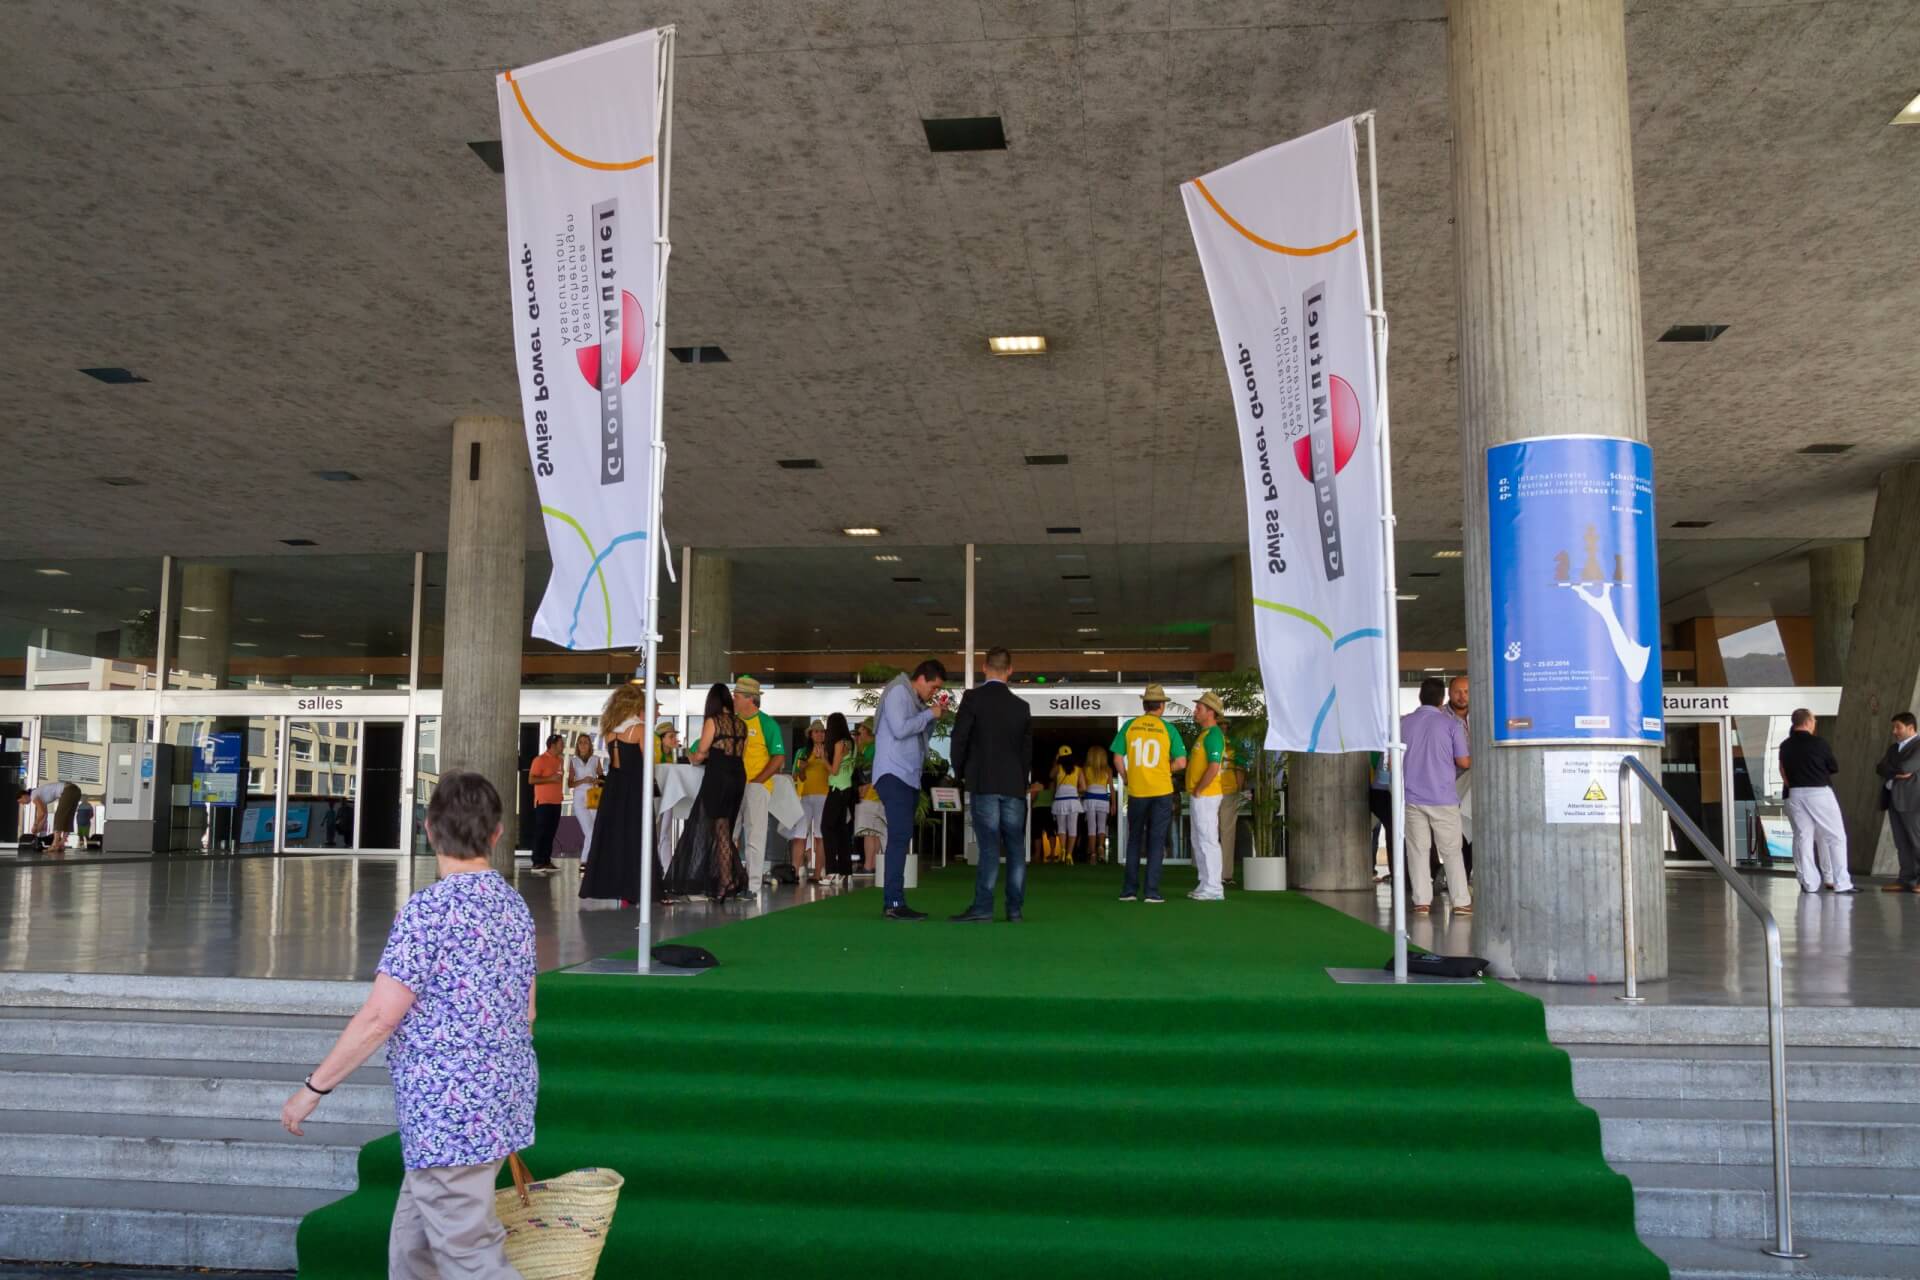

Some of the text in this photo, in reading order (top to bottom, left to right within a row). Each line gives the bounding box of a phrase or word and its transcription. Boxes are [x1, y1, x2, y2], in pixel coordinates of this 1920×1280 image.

[1582, 486, 1609, 495] Chess
[298, 695, 343, 710] salles
[1049, 695, 1101, 710] salles
[1662, 695, 1729, 709] taurant
[1131, 737, 1161, 768] 10
